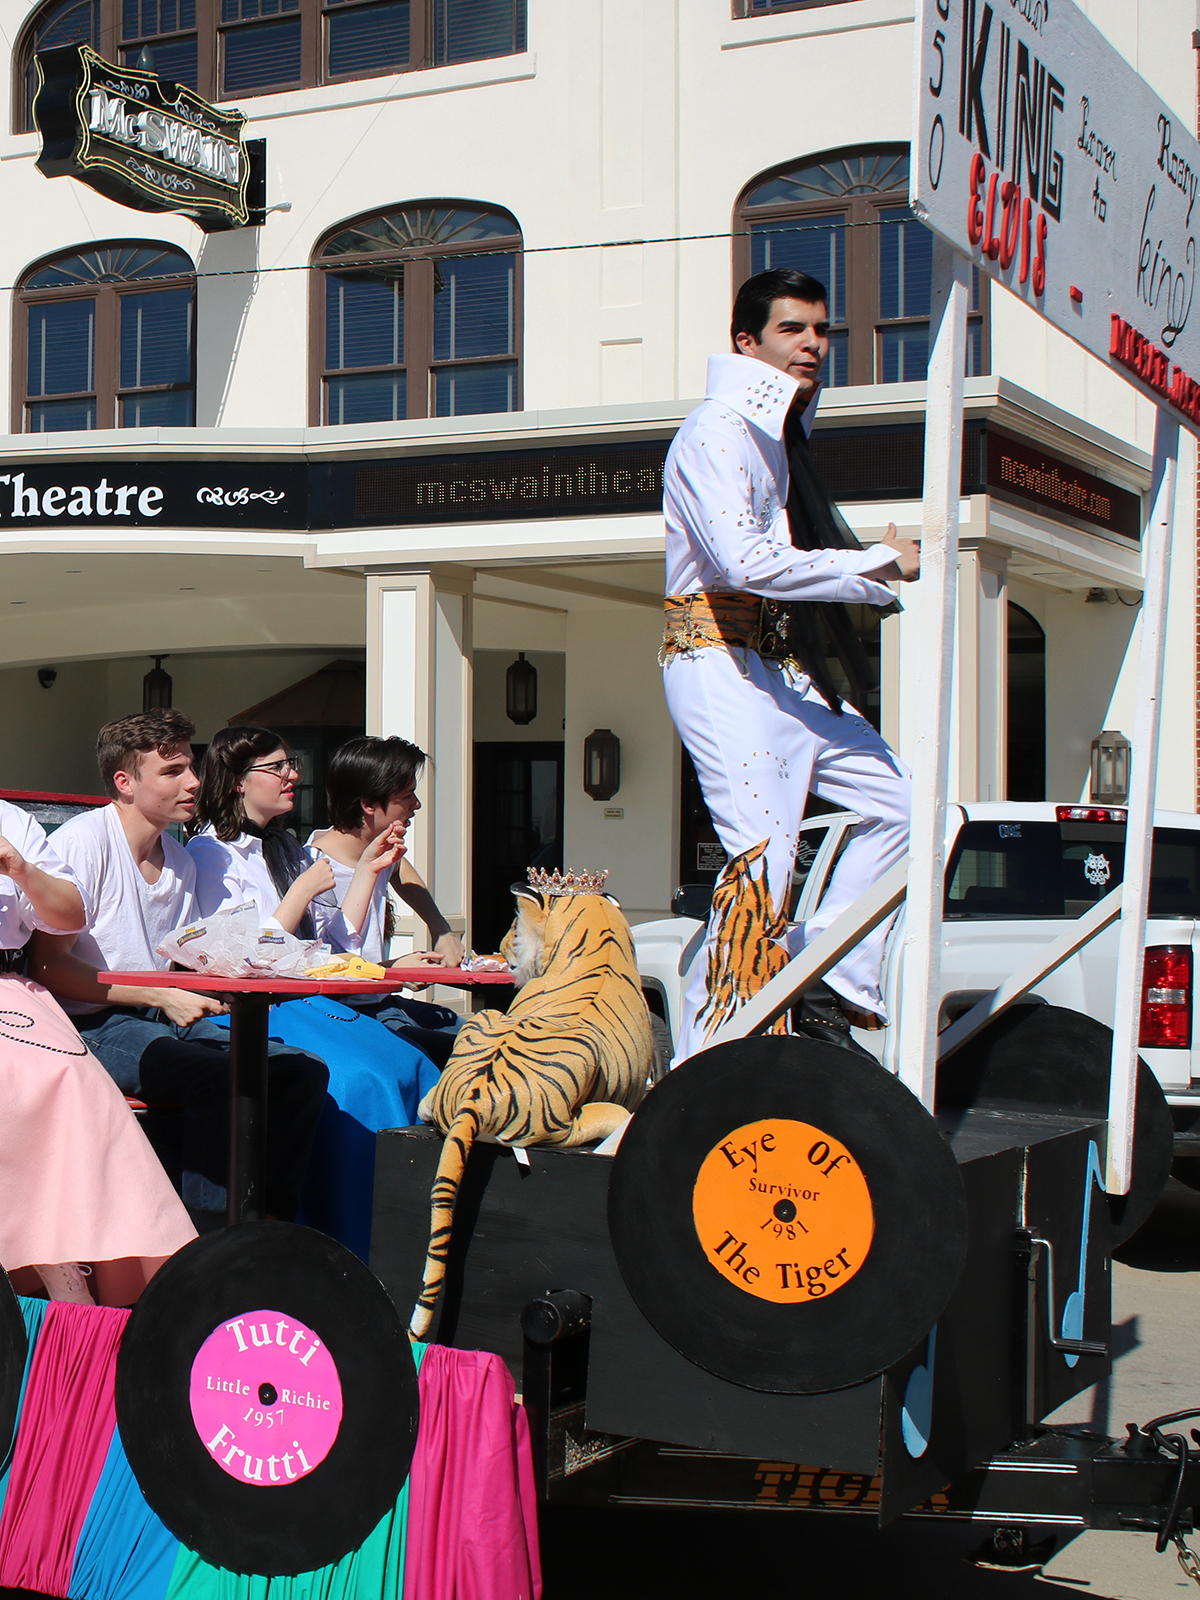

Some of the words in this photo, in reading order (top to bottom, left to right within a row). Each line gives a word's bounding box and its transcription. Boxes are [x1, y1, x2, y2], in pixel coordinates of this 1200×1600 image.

[959, 0, 1066, 223] KING
[1092, 176, 1107, 223] to
[719, 1132, 777, 1173] Eye
[807, 1140, 851, 1178] Of
[749, 1177, 820, 1202] Survivor
[759, 1218, 809, 1241] 1981
[713, 1230, 761, 1284] The
[775, 1247, 852, 1297] Tiger
[225, 1319, 321, 1367] Tutti
[206, 1376, 251, 1395] Little
[281, 1388, 331, 1410] Richie
[243, 1407, 285, 1429] 1957
[206, 1423, 312, 1482] Frutti
